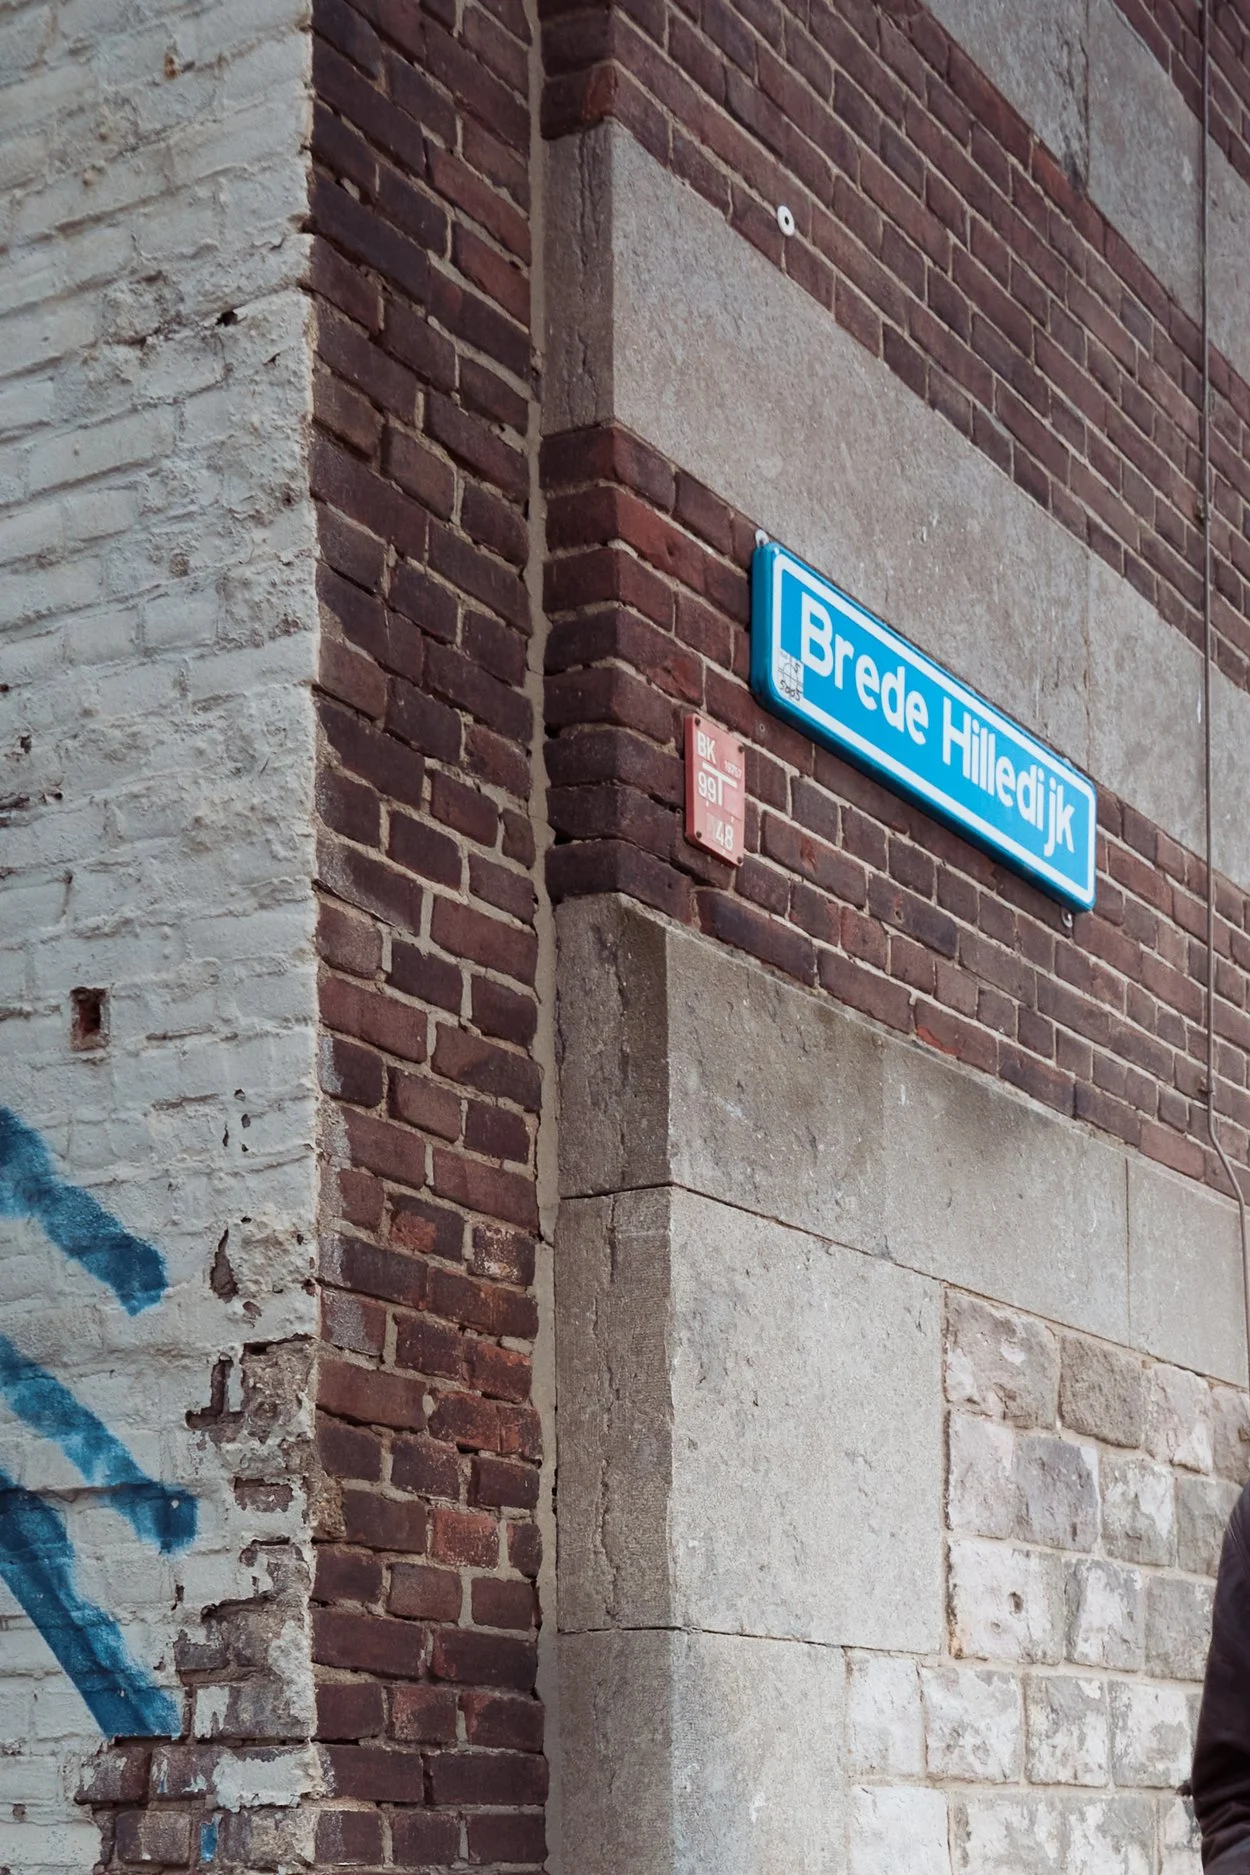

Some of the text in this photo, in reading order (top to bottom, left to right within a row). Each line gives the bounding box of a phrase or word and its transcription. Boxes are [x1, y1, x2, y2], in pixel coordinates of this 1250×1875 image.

[801, 592, 1075, 857] Brede Hilledijk
[697, 731, 717, 765] BK
[715, 820, 735, 851] 48
